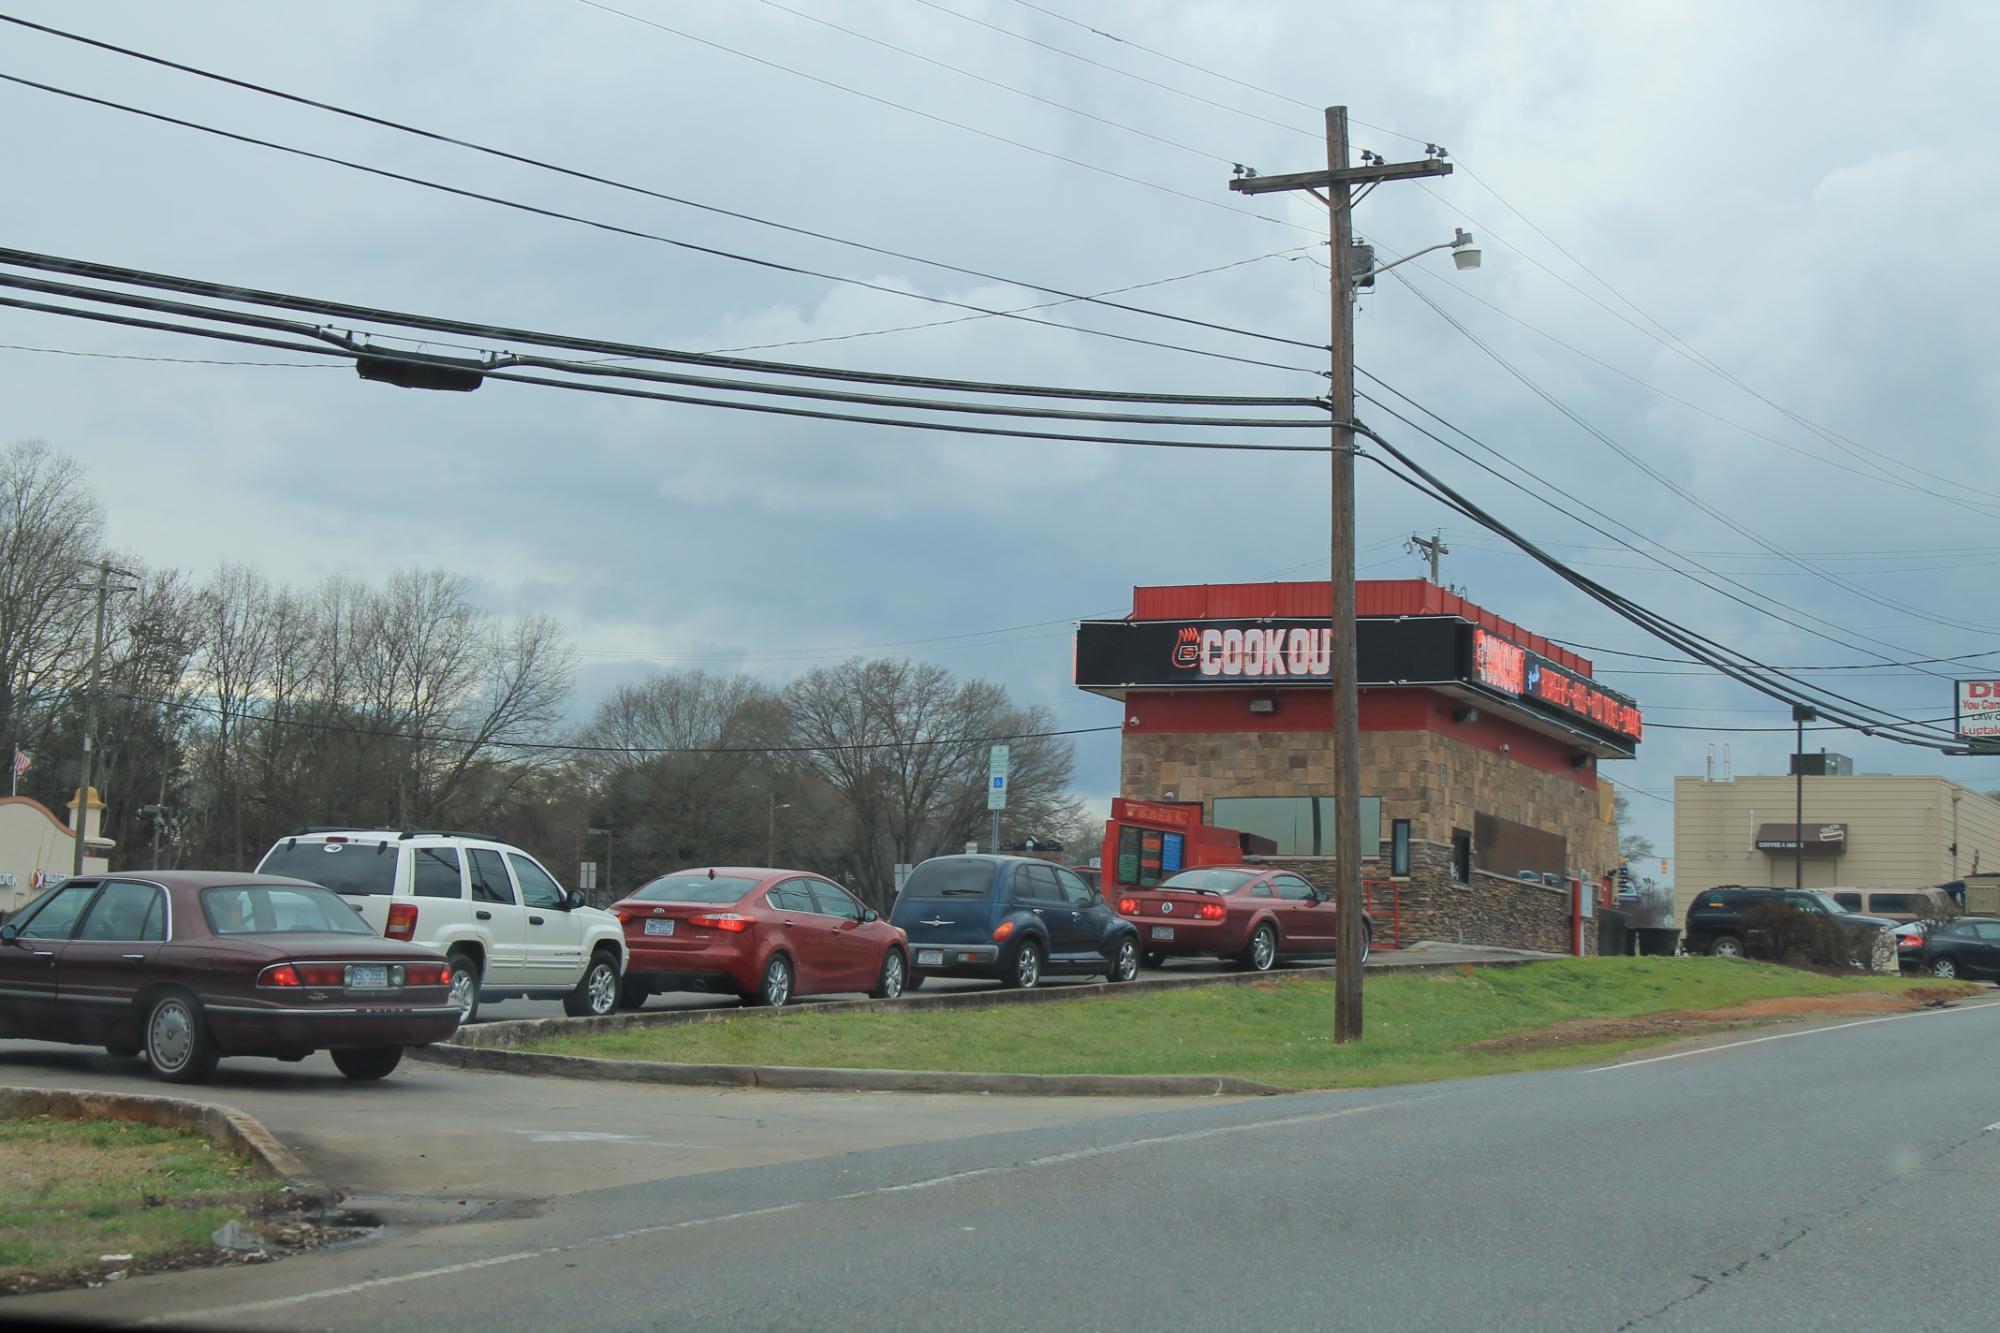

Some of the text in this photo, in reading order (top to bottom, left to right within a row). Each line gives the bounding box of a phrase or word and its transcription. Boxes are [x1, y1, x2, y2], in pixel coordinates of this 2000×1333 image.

[1200, 628, 1334, 676] COOKOU
[1962, 699, 1979, 710] You
[1972, 713, 1992, 721] LAW
[1786, 841, 1804, 849] MOE
